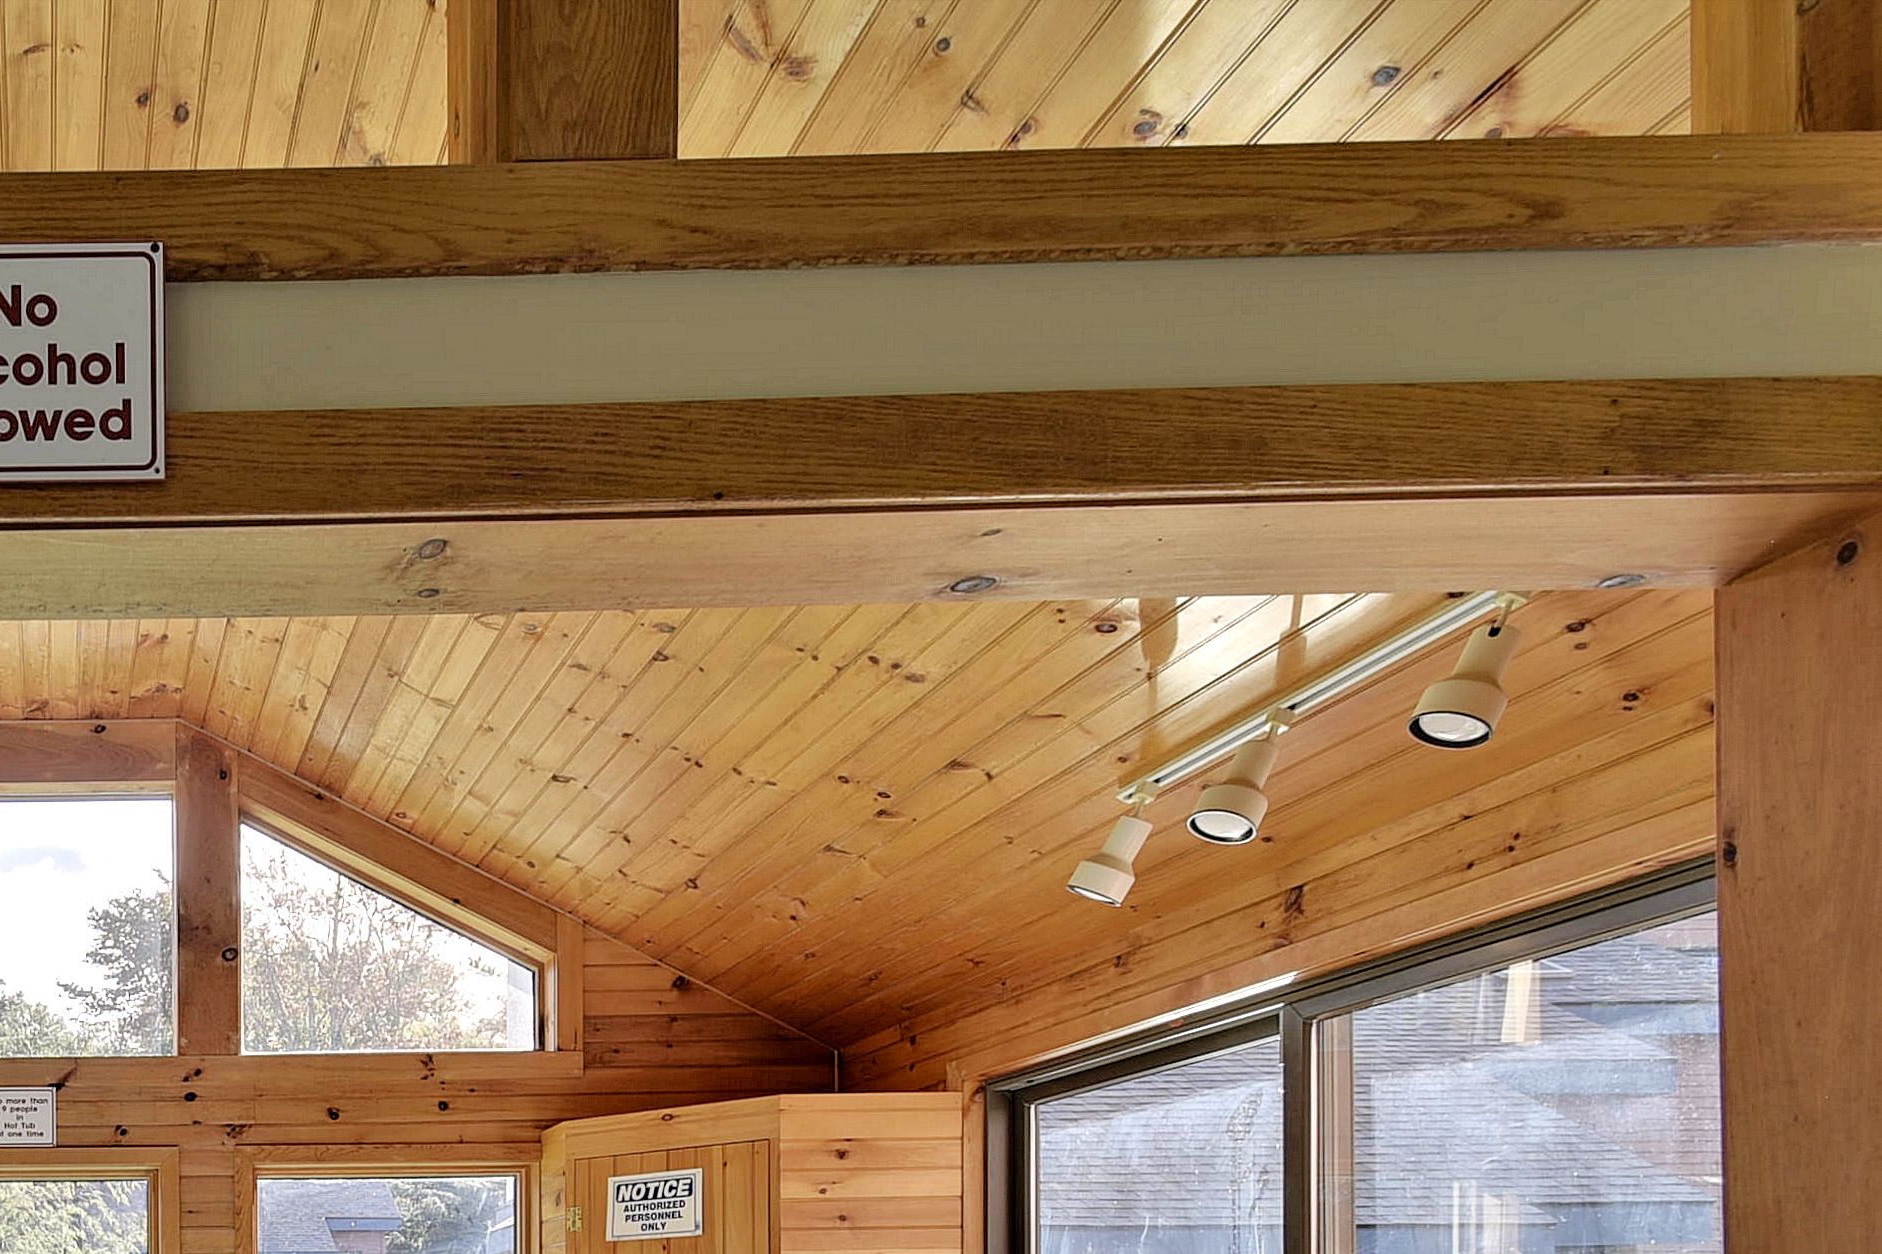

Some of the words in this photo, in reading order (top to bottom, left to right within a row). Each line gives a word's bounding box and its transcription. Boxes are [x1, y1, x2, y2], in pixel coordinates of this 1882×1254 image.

[618, 1179, 691, 1201] NOTICE
[623, 1200, 686, 1213] AUTHORIZED
[625, 1210, 683, 1223] PERSONNEL
[641, 1222, 667, 1232] ONLY
